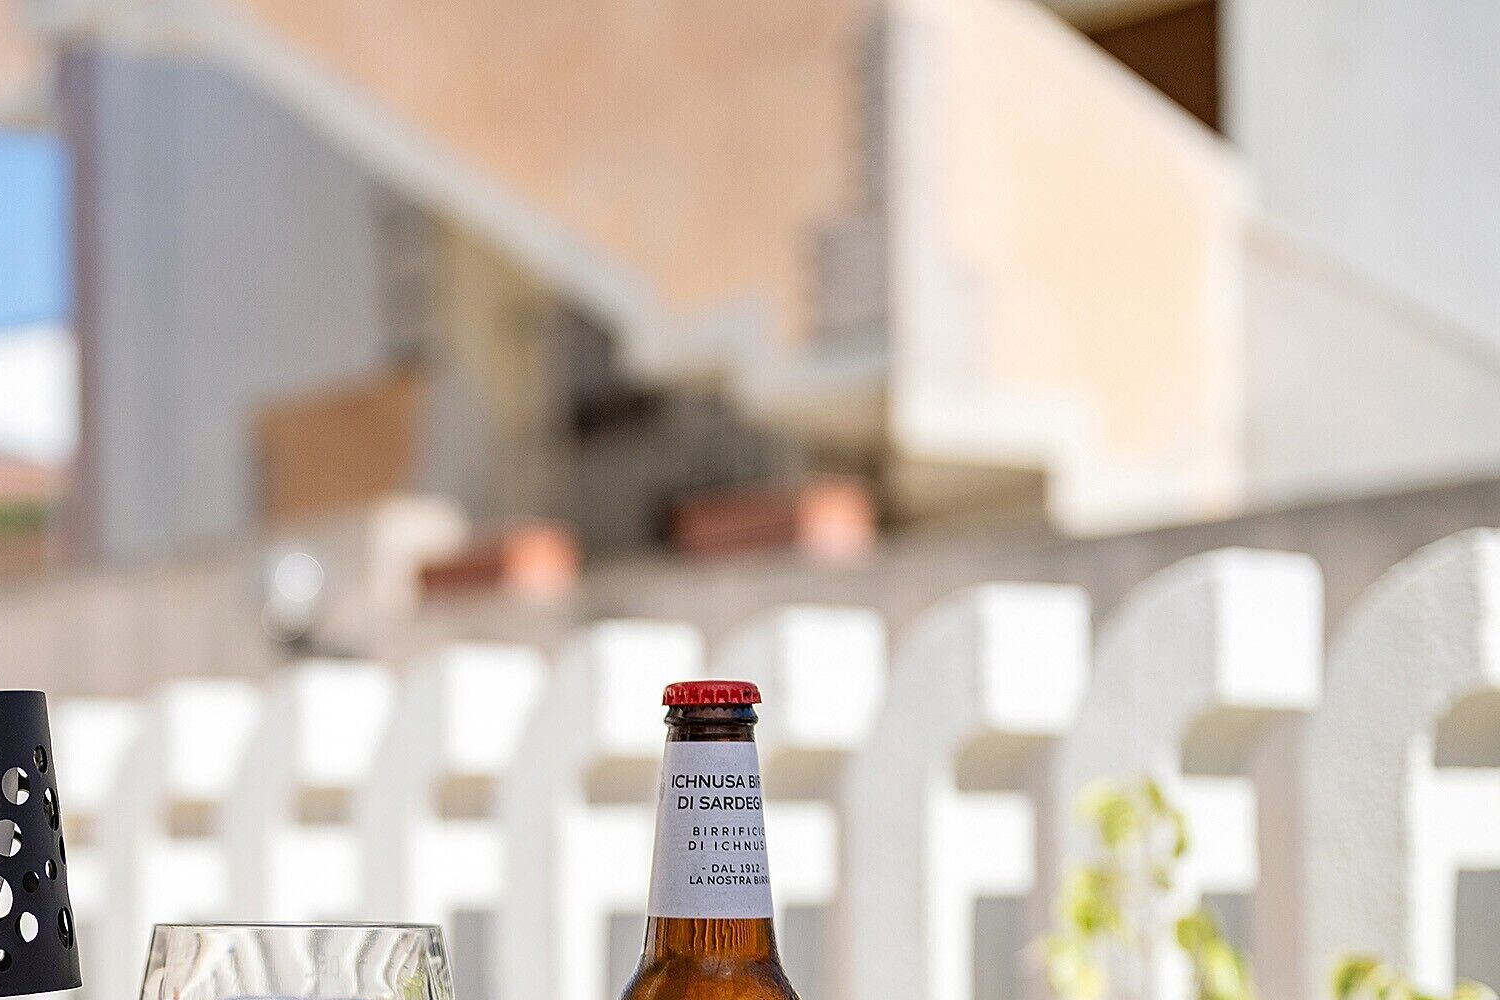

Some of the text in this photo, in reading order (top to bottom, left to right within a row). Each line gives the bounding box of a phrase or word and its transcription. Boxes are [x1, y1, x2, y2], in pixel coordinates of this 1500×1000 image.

[671, 774, 746, 789] ICHNUSA
[677, 796, 694, 810] DI
[688, 841, 767, 851] DI ICHNUS
[711, 863, 736, 873] DAL
[740, 863, 760, 873] 1912
[689, 876, 703, 885] LA
[707, 876, 752, 885] NOSTRA
